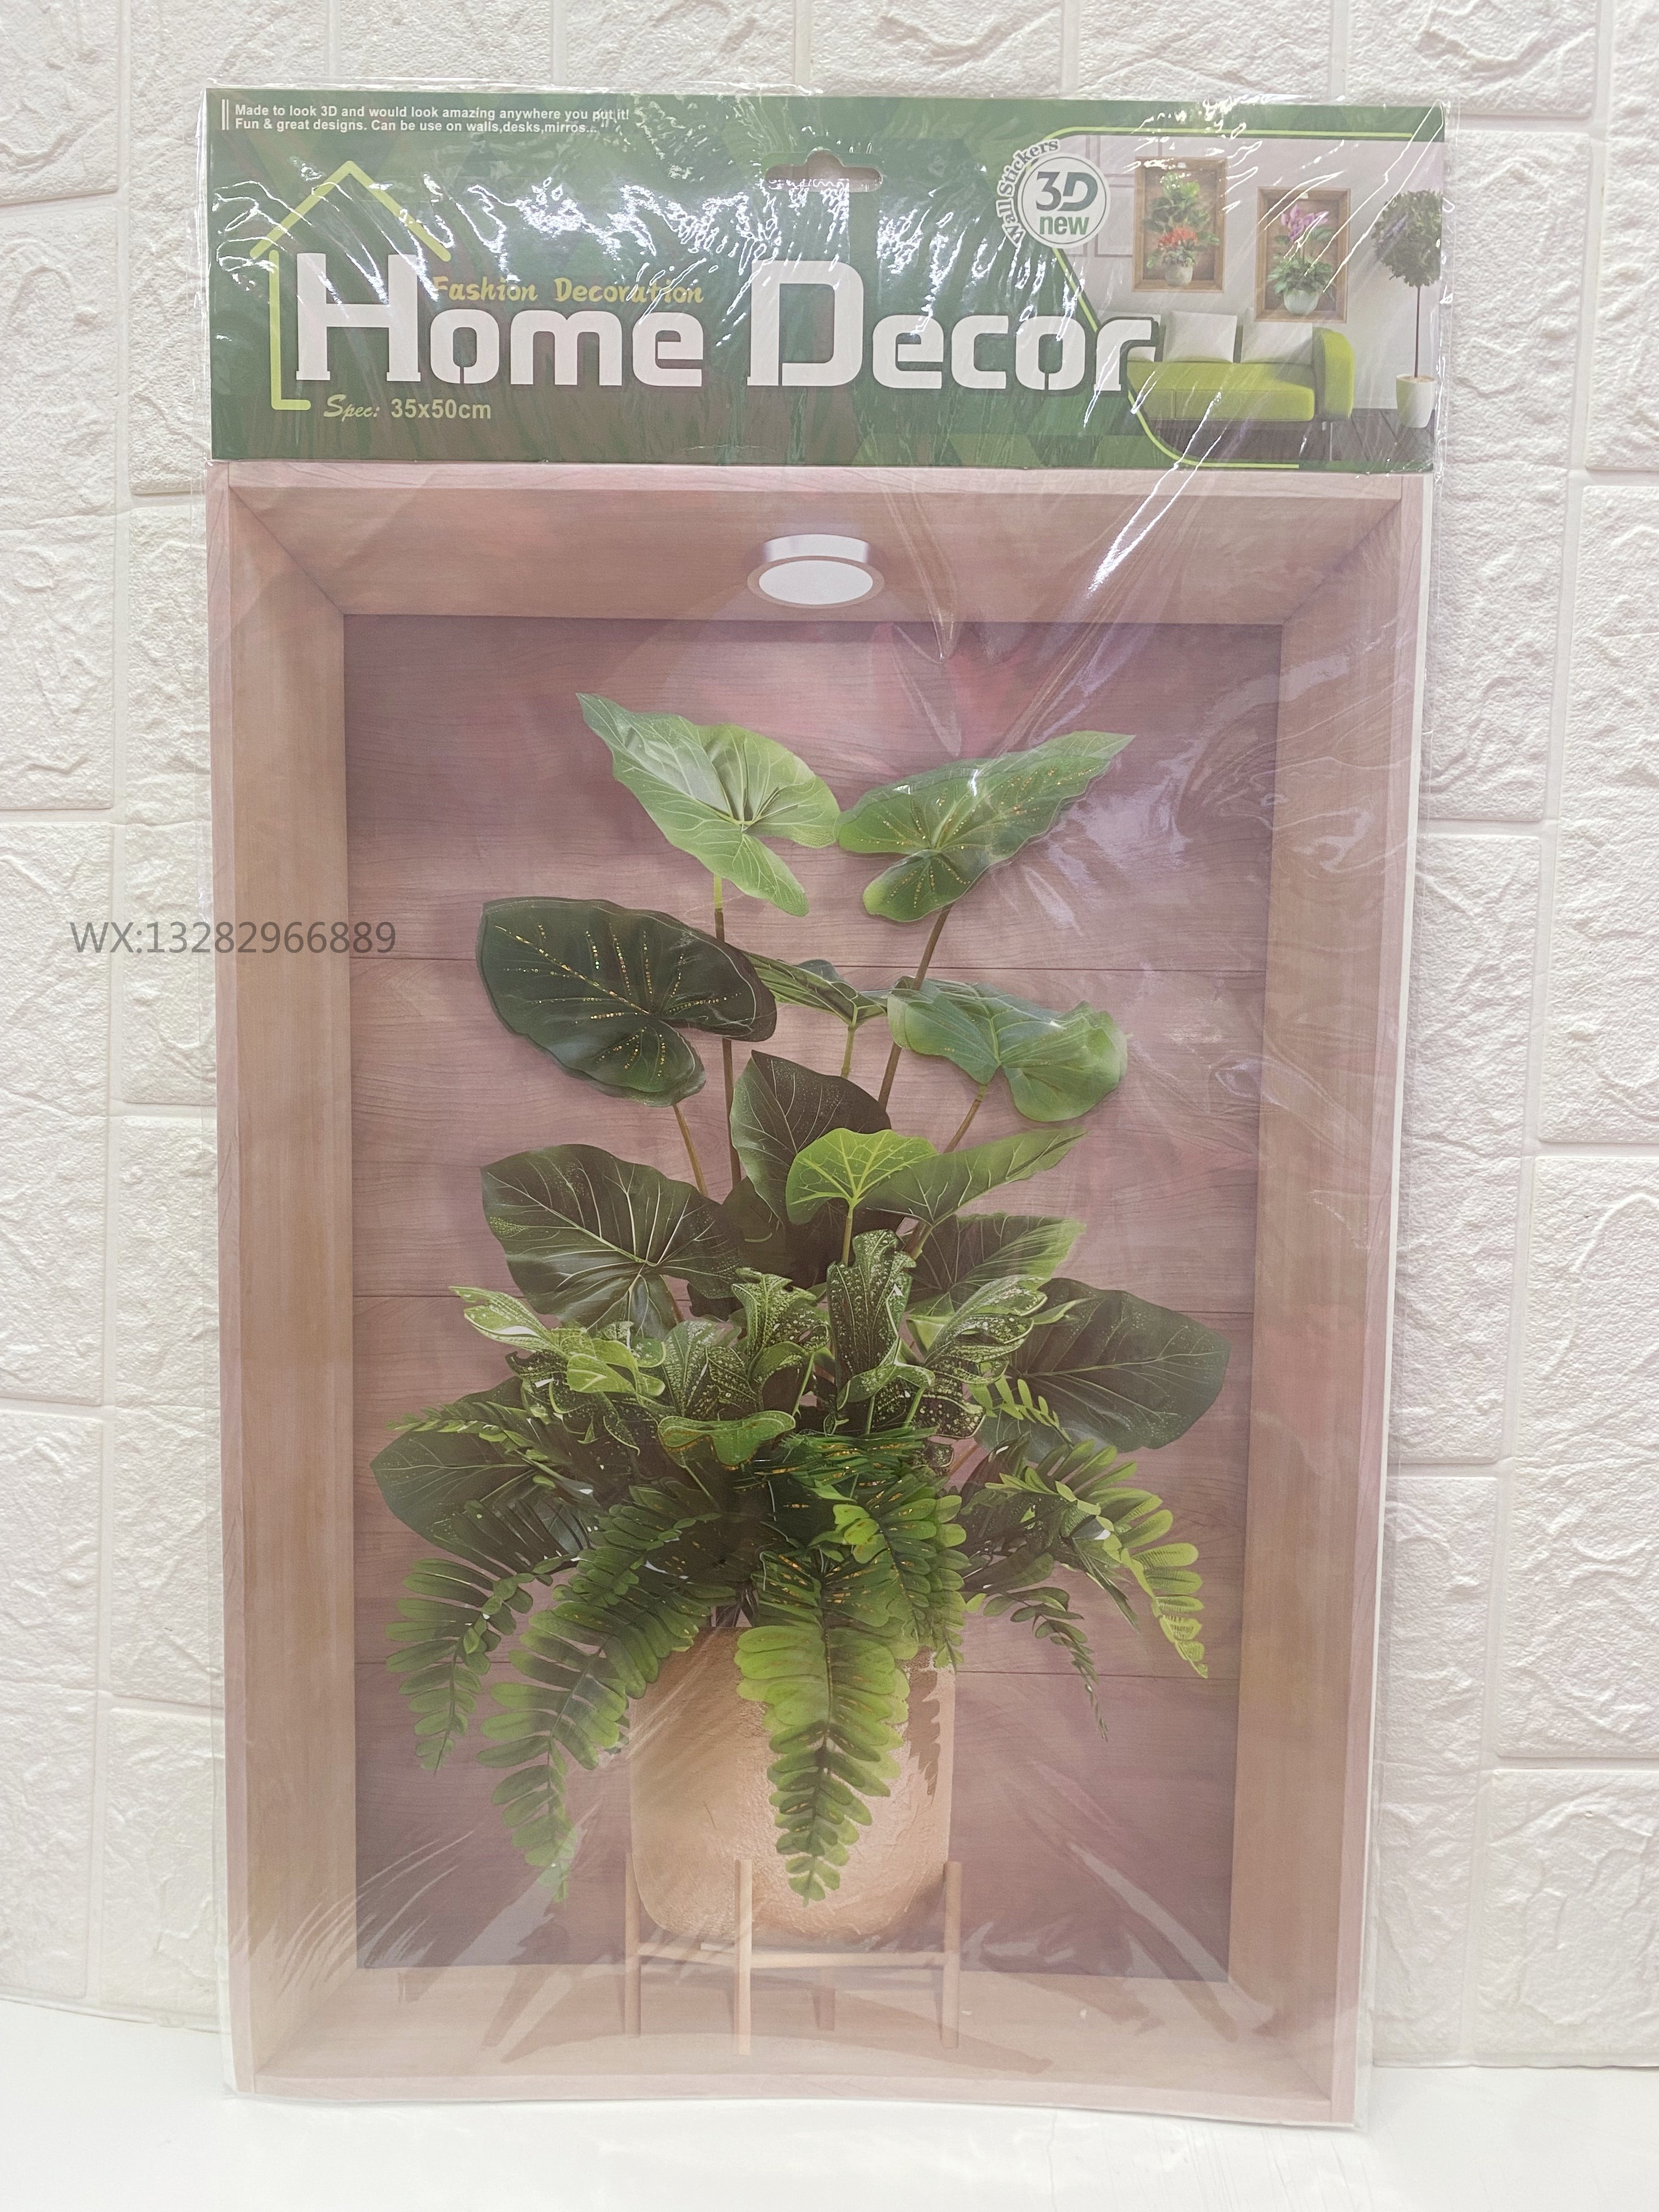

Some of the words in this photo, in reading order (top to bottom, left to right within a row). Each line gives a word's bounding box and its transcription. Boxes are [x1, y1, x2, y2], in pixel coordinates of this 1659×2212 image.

[235, 104, 269, 116] Made
[273, 105, 285, 116] to
[290, 105, 317, 116] look
[321, 105, 337, 117] 3D
[341, 106, 365, 117] and
[369, 106, 407, 117] would
[411, 106, 438, 117] look
[443, 108, 495, 121] amazing
[499, 108, 561, 121] anywhere
[565, 110, 588, 122] you
[592, 109, 616, 122] put
[617, 109, 629, 120] it!
[235, 118, 259, 129] Fun
[263, 119, 273, 129] &
[276, 119, 309, 132] great
[313, 119, 367, 133] designs.
[371, 120, 396, 131] Can
[400, 120, 415, 131] be
[420, 121, 442, 131] use
[446, 122, 462, 132] on
[466, 121, 597, 134] walls,desks,mirros...
[999, 140, 1058, 195] Stickers
[1035, 171, 1098, 212] 3D
[997, 200, 1026, 245] Wall
[1039, 216, 1090, 235] new
[432, 276, 538, 302] Fashion
[554, 277, 704, 303] Decoration
[296, 252, 704, 387] Home
[747, 260, 1153, 391] Decor
[323, 394, 380, 422] Spec:
[391, 398, 491, 420] 35x50cm
